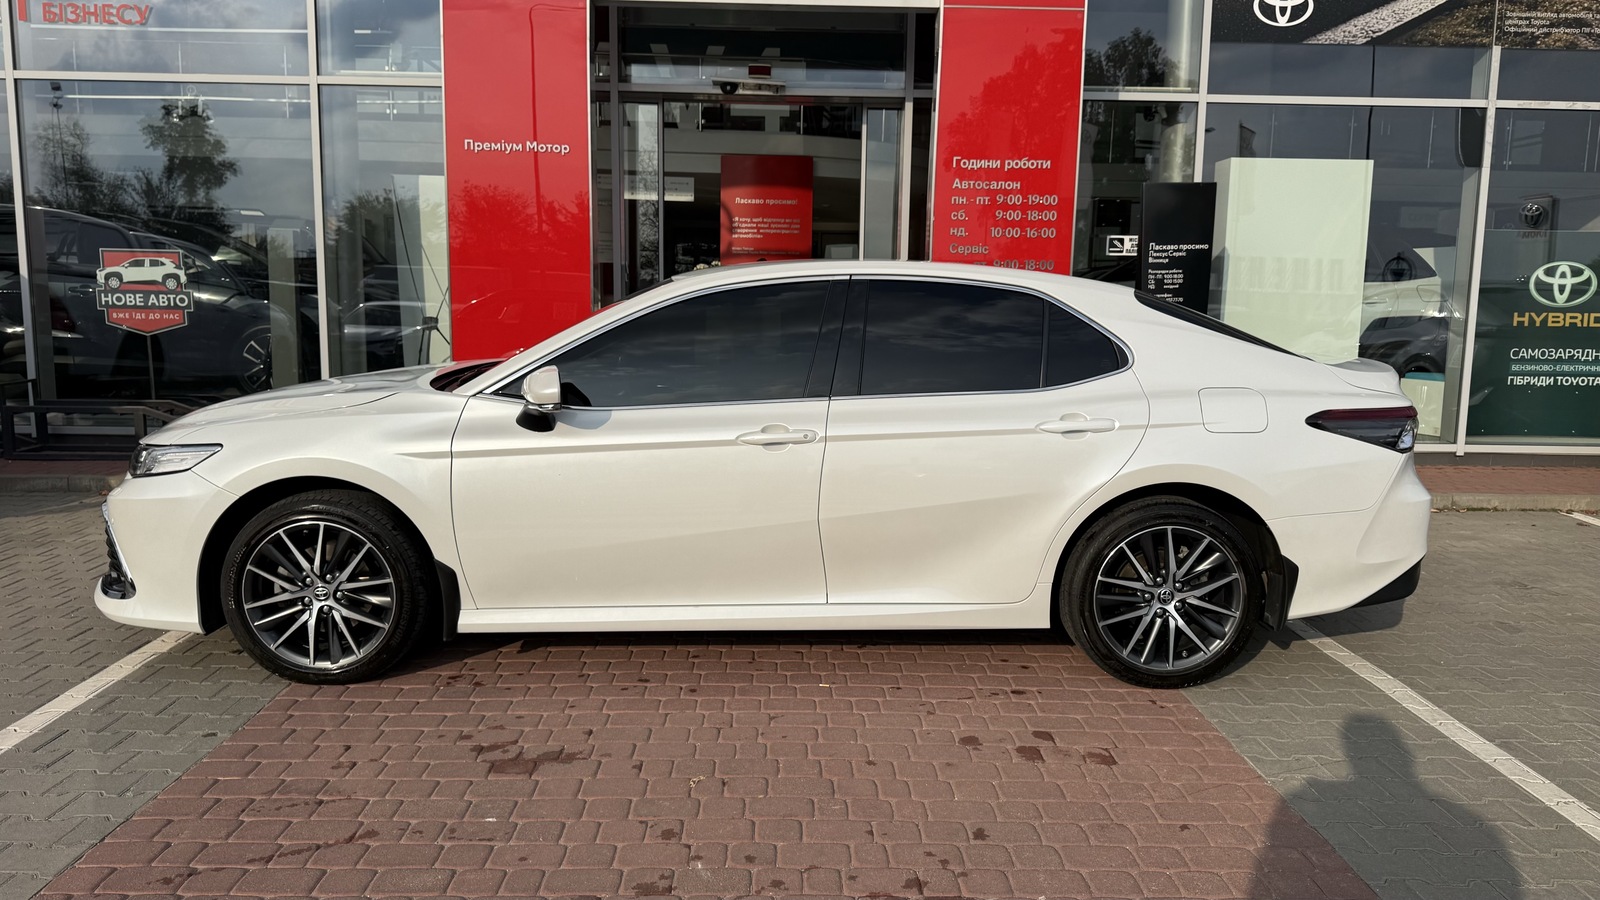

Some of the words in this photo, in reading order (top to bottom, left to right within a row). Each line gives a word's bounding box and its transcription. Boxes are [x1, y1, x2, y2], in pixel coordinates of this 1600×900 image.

[42, 2, 150, 25] БІЗНЕСУ
[464, 139, 523, 154] Преміум
[526, 141, 570, 155] Мотор
[952, 156, 1001, 170] Години
[1004, 157, 1051, 172] роботи
[952, 178, 1021, 190] Автосалон
[735, 197, 764, 205] Ласкаво
[996, 194, 1059, 206] 9:00-19:00
[951, 209, 969, 221] сб.
[995, 210, 1058, 222] 9:00-18:00
[950, 227, 969, 238] нд.
[990, 227, 1057, 239] 10:00-16:00
[949, 242, 990, 256] Сервіс
[1149, 242, 1178, 250] Ласкаво
[1179, 244, 1209, 252] просимо
[101, 293, 144, 306] НОВЕ
[148, 294, 189, 307] АВТО
[132, 311, 146, 319] ЇДЕ
[148, 312, 161, 320] ДО
[1512, 312, 1600, 328] HYBRID
[1507, 376, 1554, 387] ГІБРИДИ
[1556, 376, 1600, 387] TOYOTA
